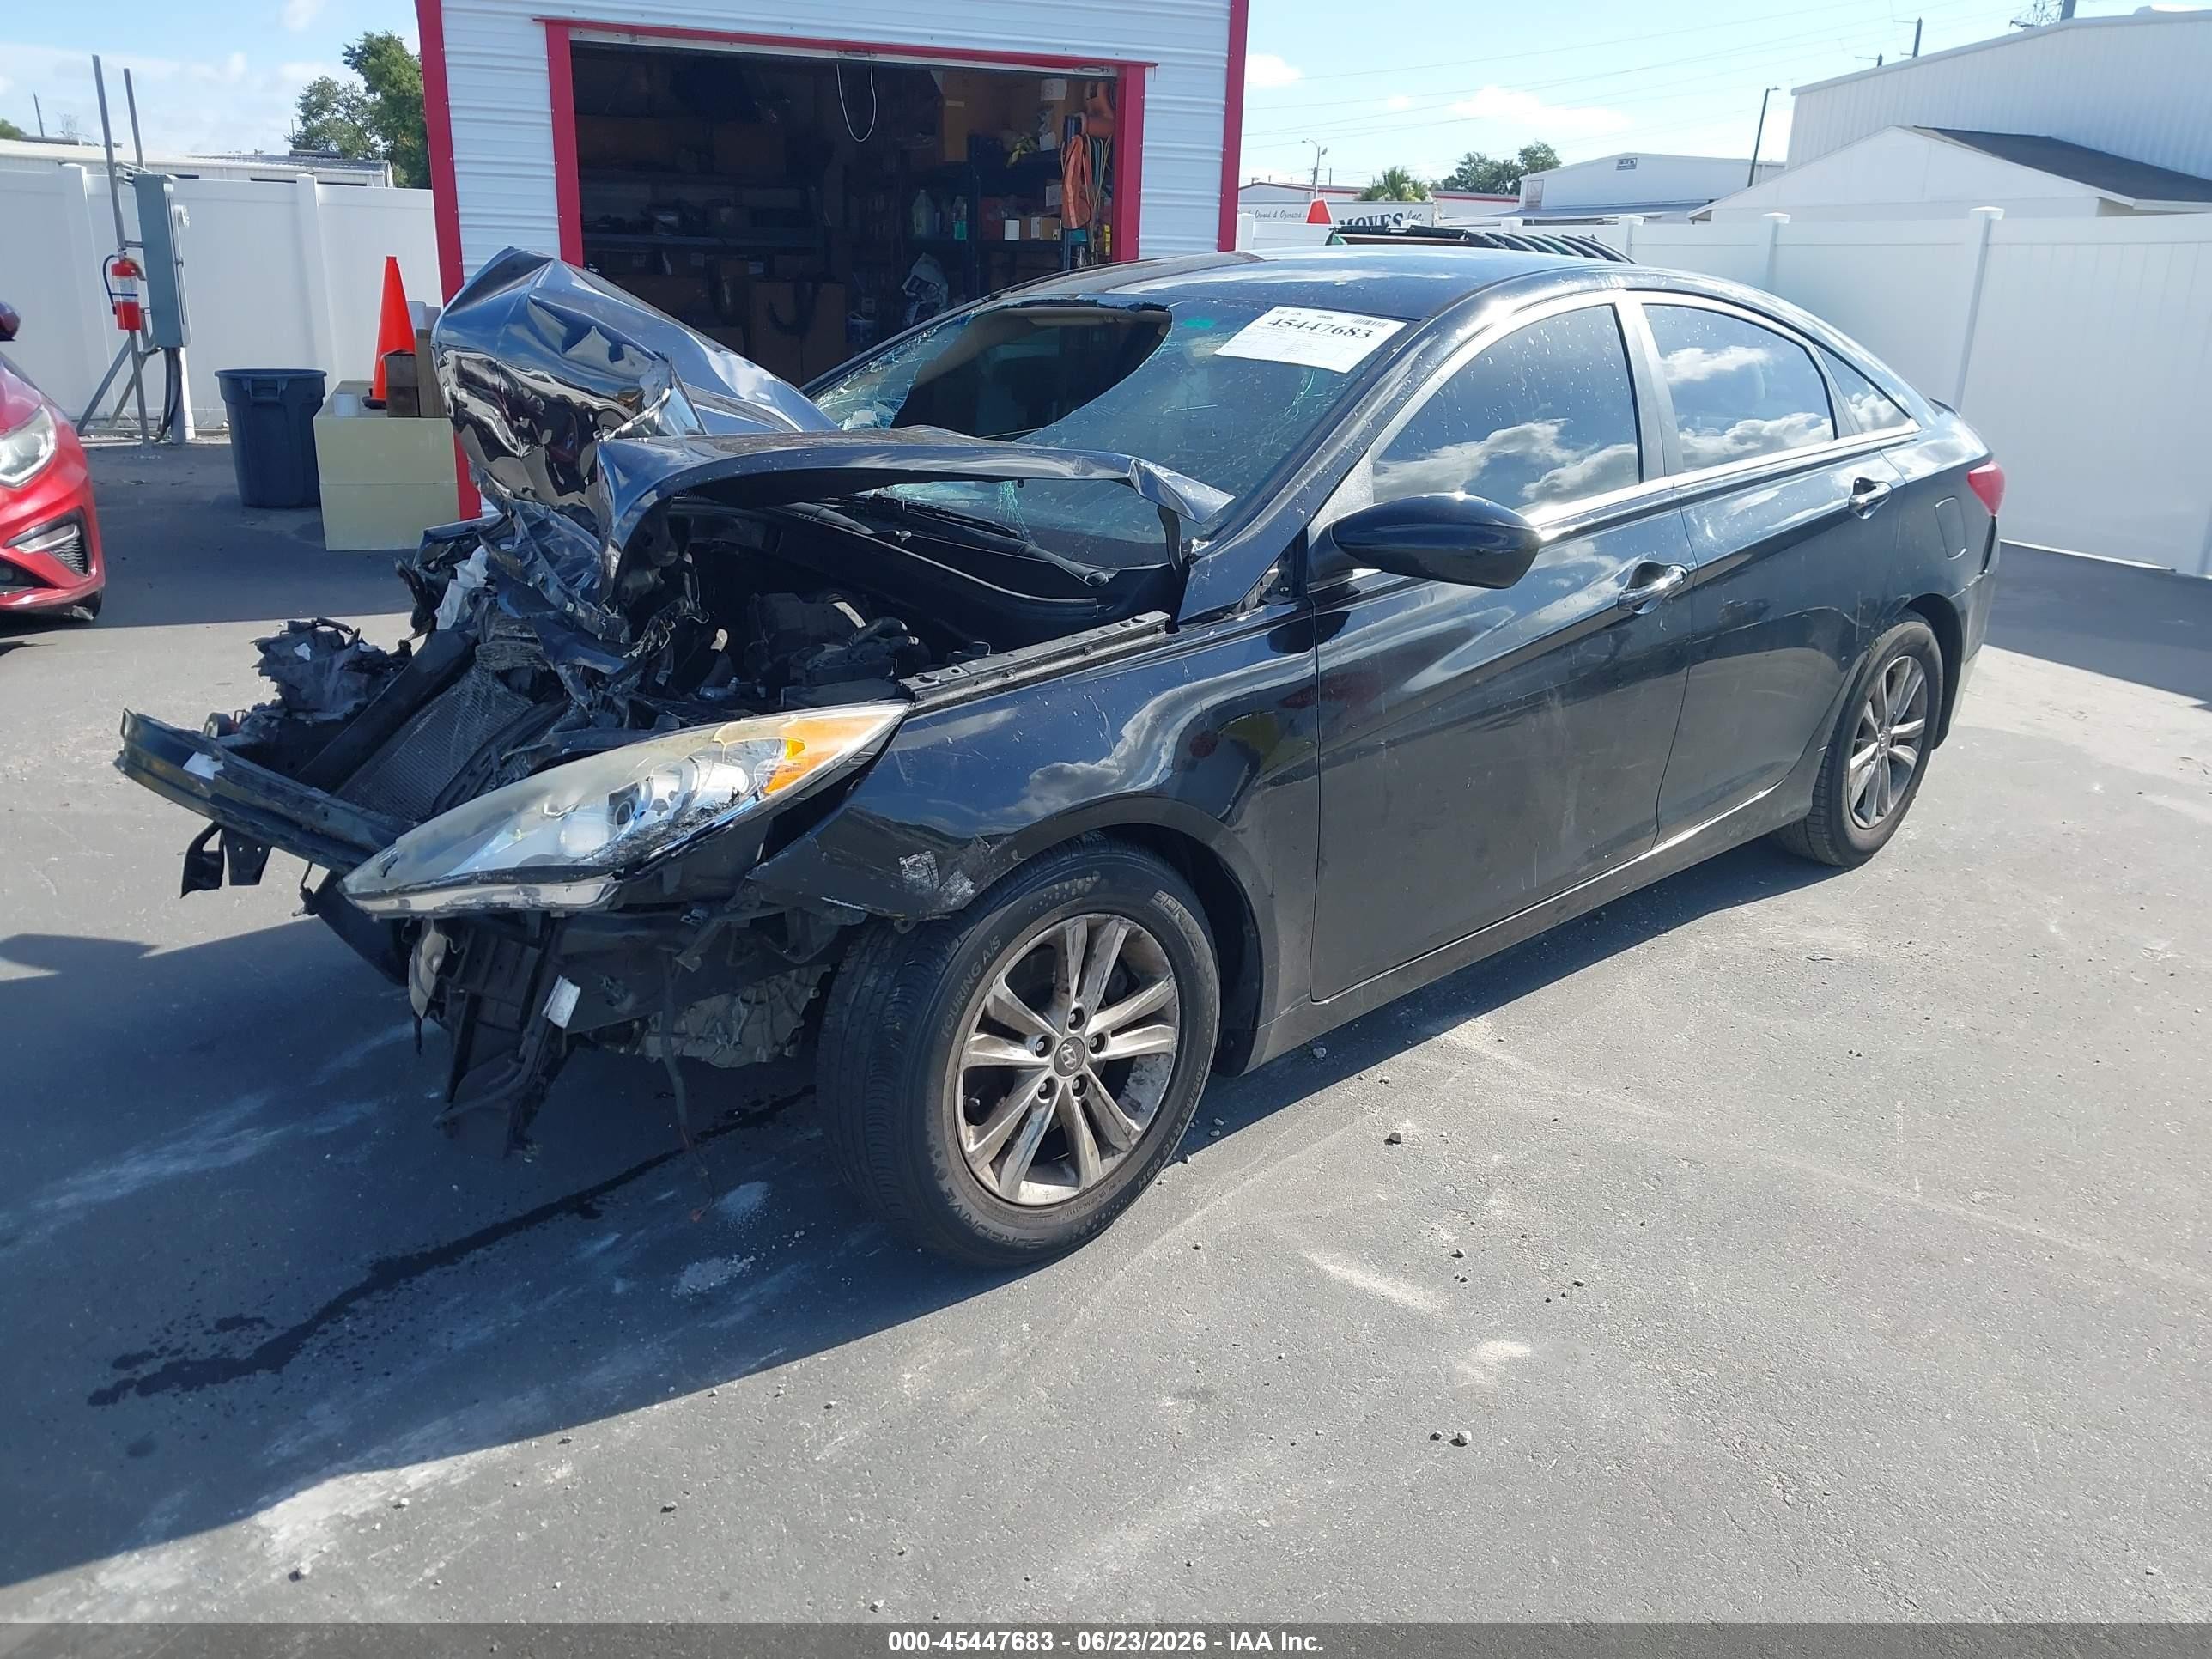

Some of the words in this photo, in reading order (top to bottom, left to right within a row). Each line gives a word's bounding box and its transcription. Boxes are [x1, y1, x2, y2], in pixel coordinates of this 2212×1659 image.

[1267, 318, 1374, 339] 45447683
[939, 961, 982, 1039] TOURING
[981, 934, 1001, 966] A/S
